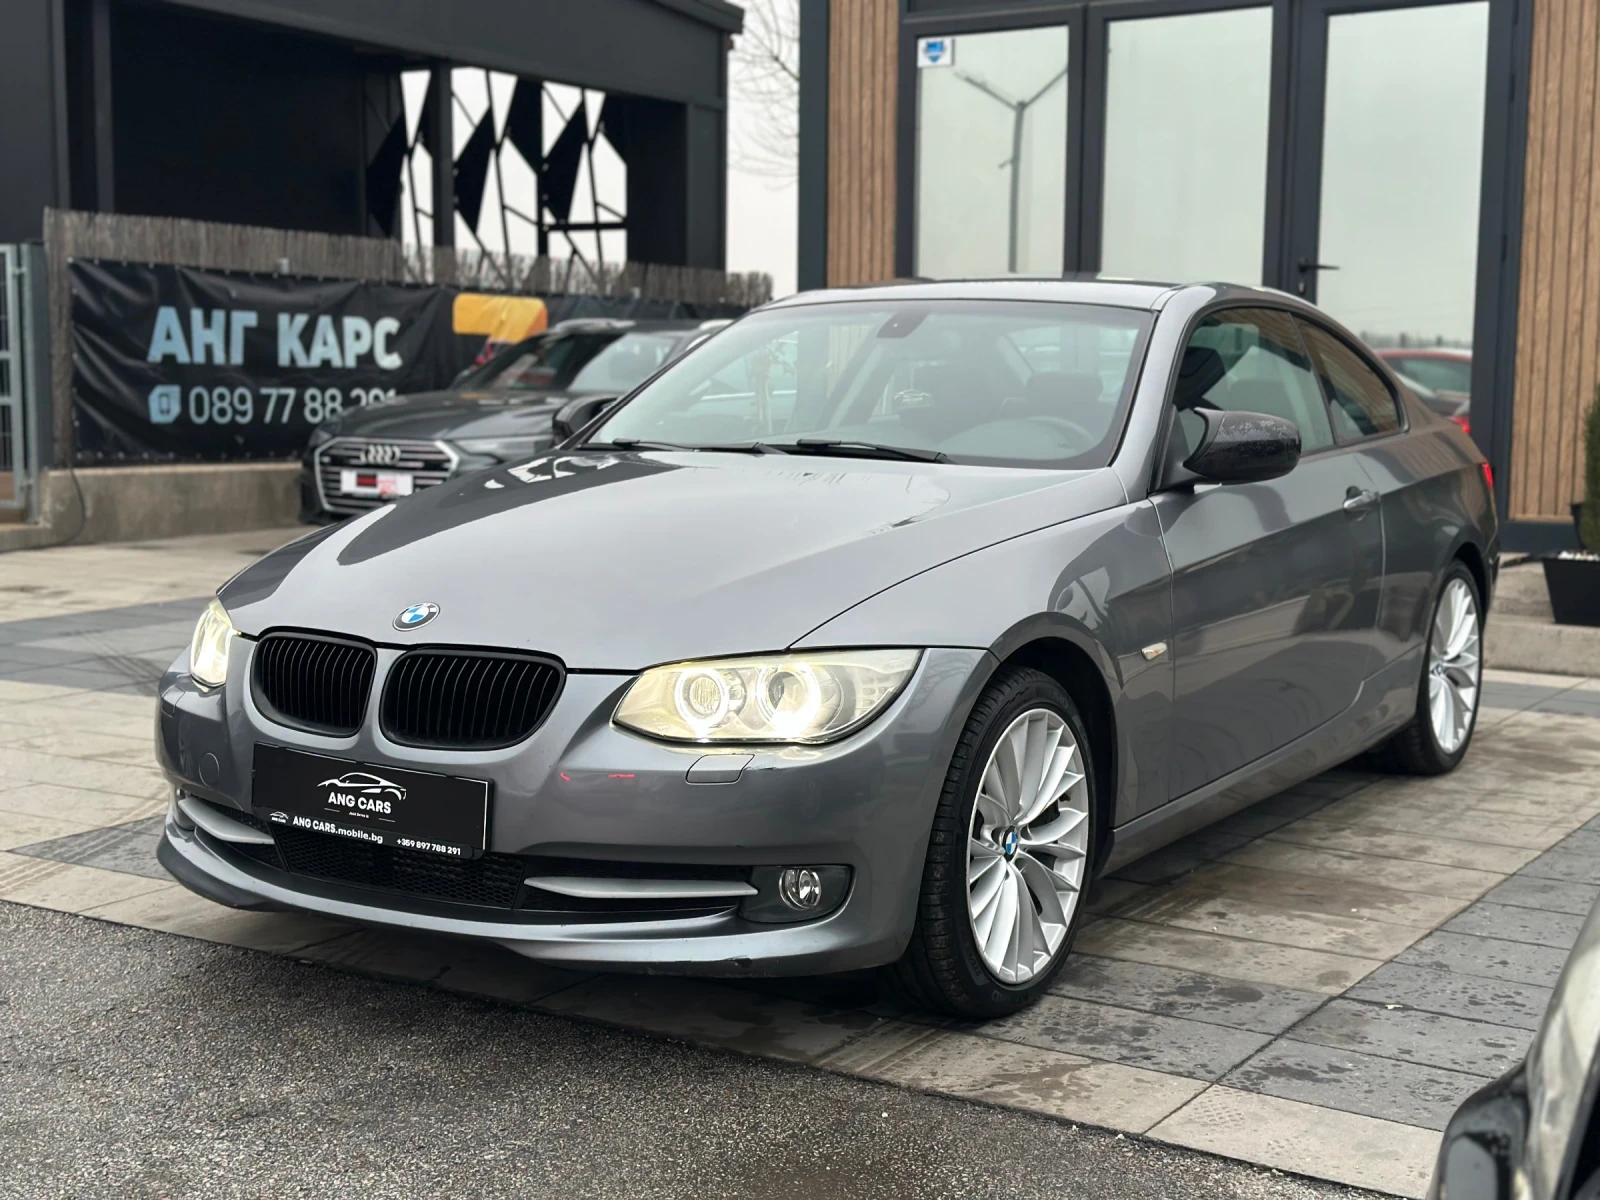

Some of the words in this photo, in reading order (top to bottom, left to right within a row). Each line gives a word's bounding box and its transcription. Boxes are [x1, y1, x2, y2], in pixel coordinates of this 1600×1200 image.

[147, 306, 258, 365] АНГ
[277, 313, 403, 370] КАРС
[189, 386, 253, 424] 089
[259, 387, 297, 424] 77
[303, 387, 343, 424] 88
[328, 791, 356, 807] ANG
[357, 796, 391, 814] CARS
[292, 815, 311, 828] ANG
[312, 820, 383, 844] CARS.mobile.bg
[397, 838, 416, 848] +359
[416, 841, 431, 851] 897
[431, 843, 447, 854] 788
[447, 846, 461, 856] 291
